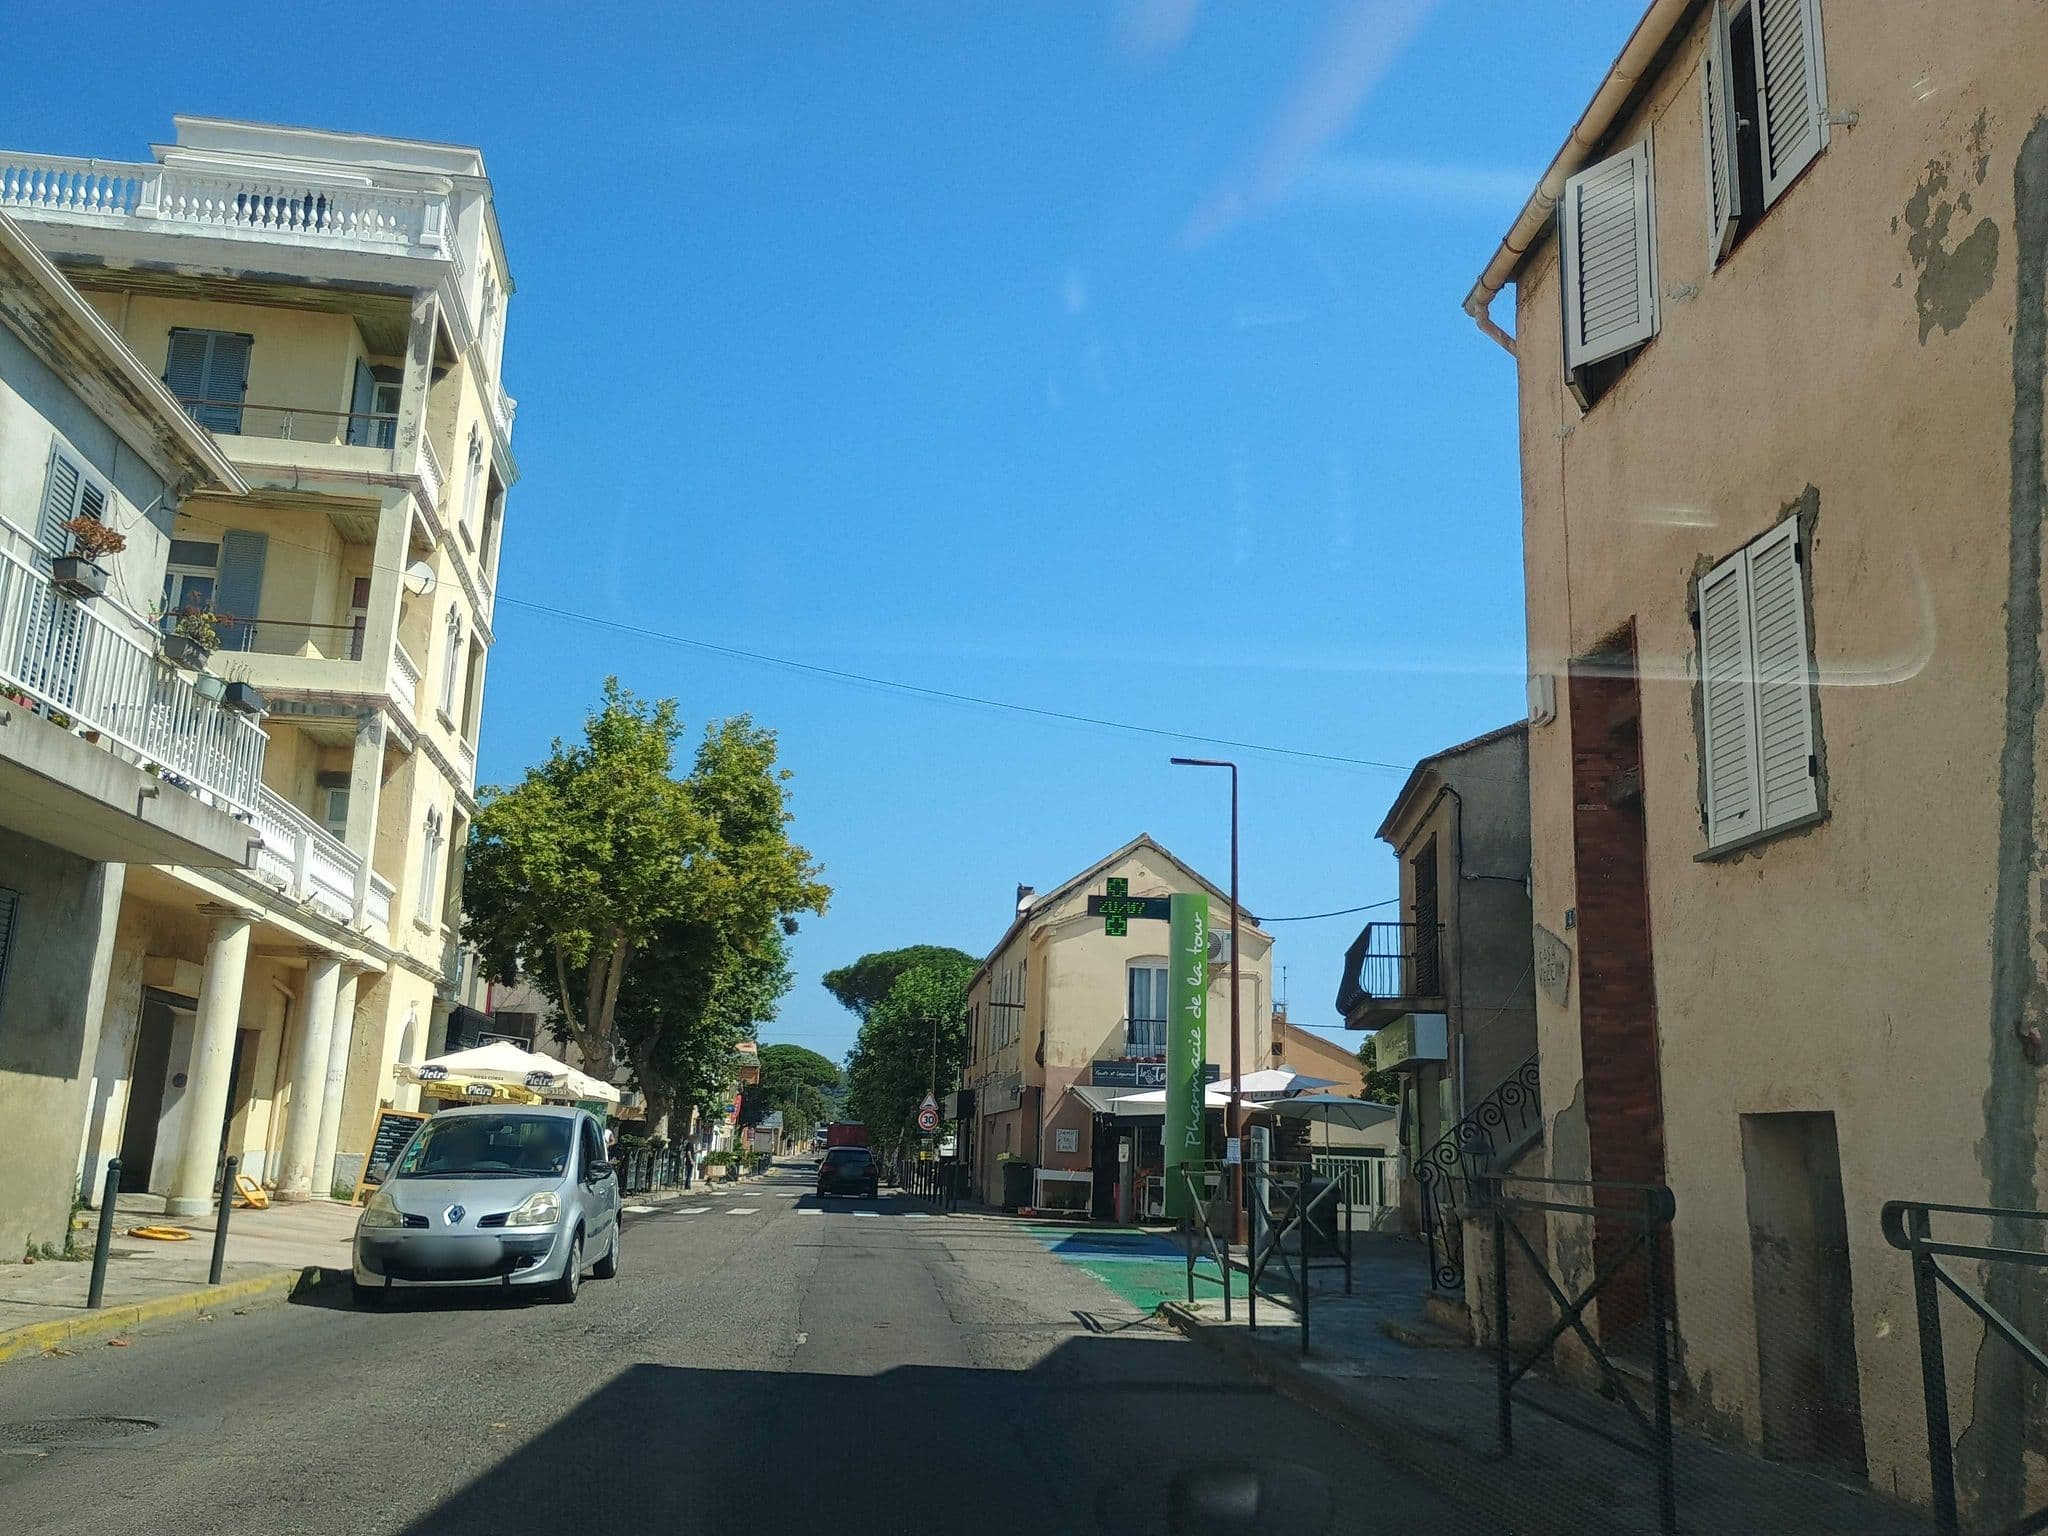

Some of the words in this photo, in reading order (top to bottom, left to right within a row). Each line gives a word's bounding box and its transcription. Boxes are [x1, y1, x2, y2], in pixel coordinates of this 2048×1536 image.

[1187, 912, 1204, 955] tour
[1187, 962, 1202, 985] la
[1185, 994, 1202, 1019] de
[418, 1069, 449, 1080] Pietra
[524, 1074, 555, 1087] Pietra
[468, 1084, 493, 1097] Pietra
[1185, 1027, 1202, 1148] Pharmacie
[923, 1116, 934, 1124] 30
